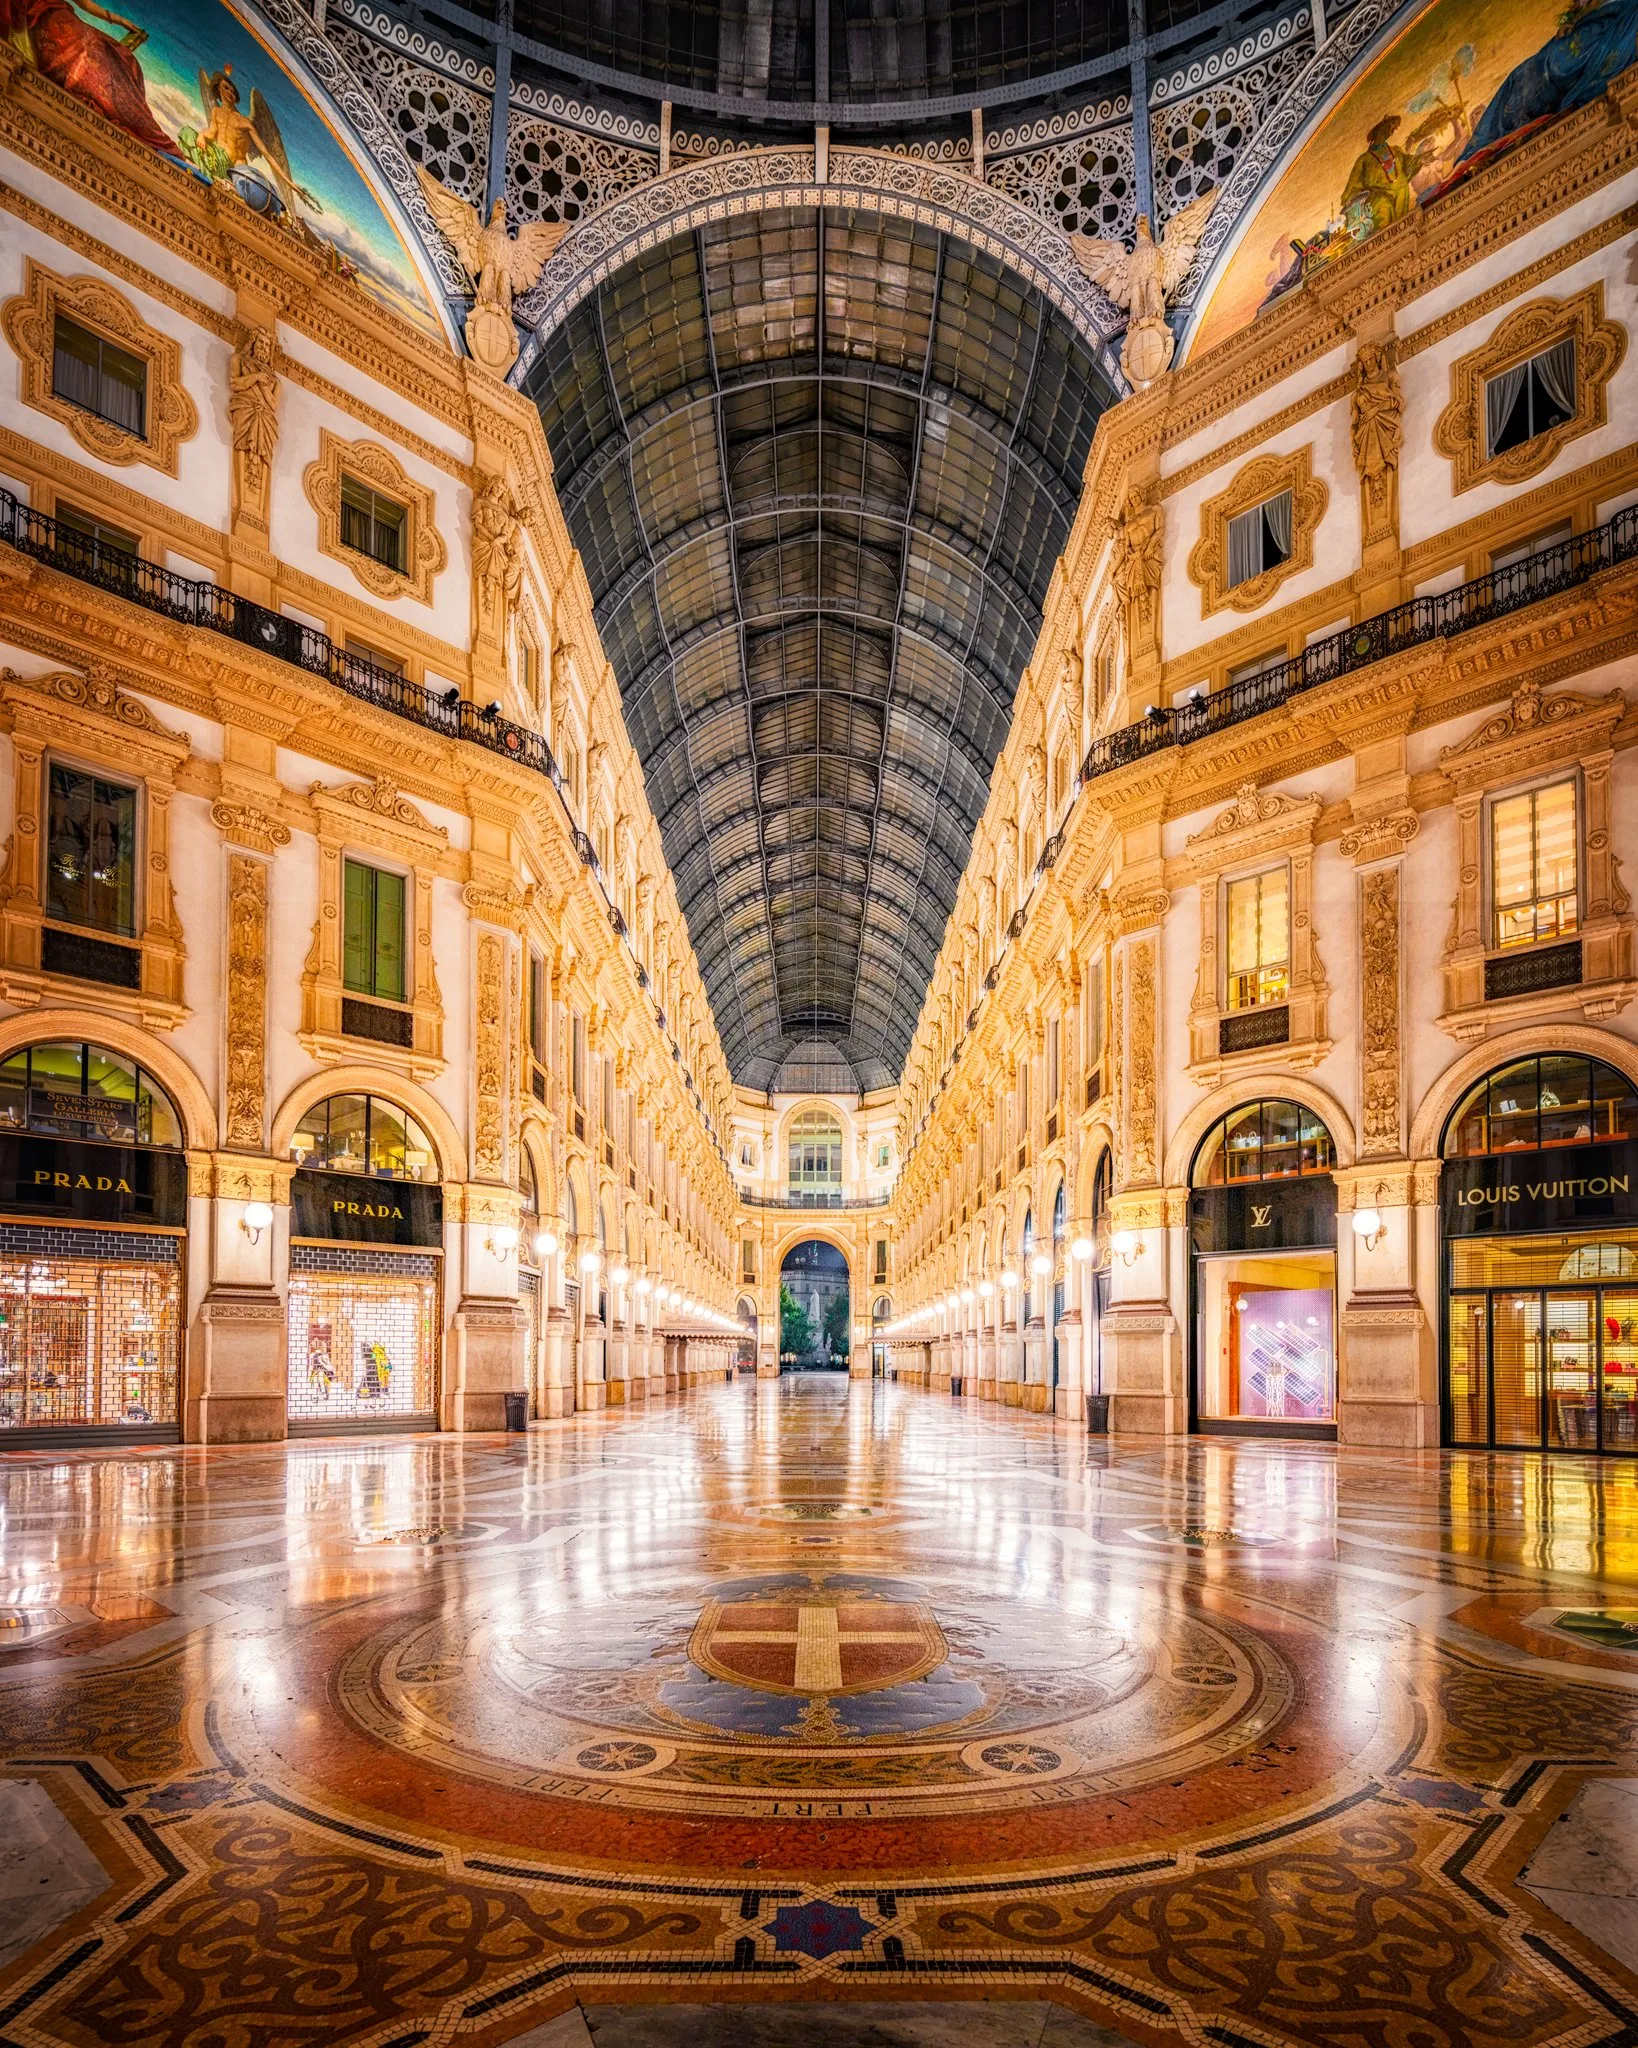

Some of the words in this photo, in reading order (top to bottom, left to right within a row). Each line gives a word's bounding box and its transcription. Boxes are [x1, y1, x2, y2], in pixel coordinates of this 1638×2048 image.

[53, 1101, 116, 1118] GALLERIA
[53, 1111, 88, 1120] LUXURY
[33, 1170, 133, 1194] PRADA
[1458, 1185, 1521, 1206] LOUIS
[1526, 1174, 1629, 1201] VUITTON
[333, 1200, 404, 1220] PRADA
[1250, 1205, 1272, 1228] LV
[515, 1776, 613, 1801] FERT
[1032, 1777, 1121, 1803] FERT
[764, 1802, 872, 1817] FERT
